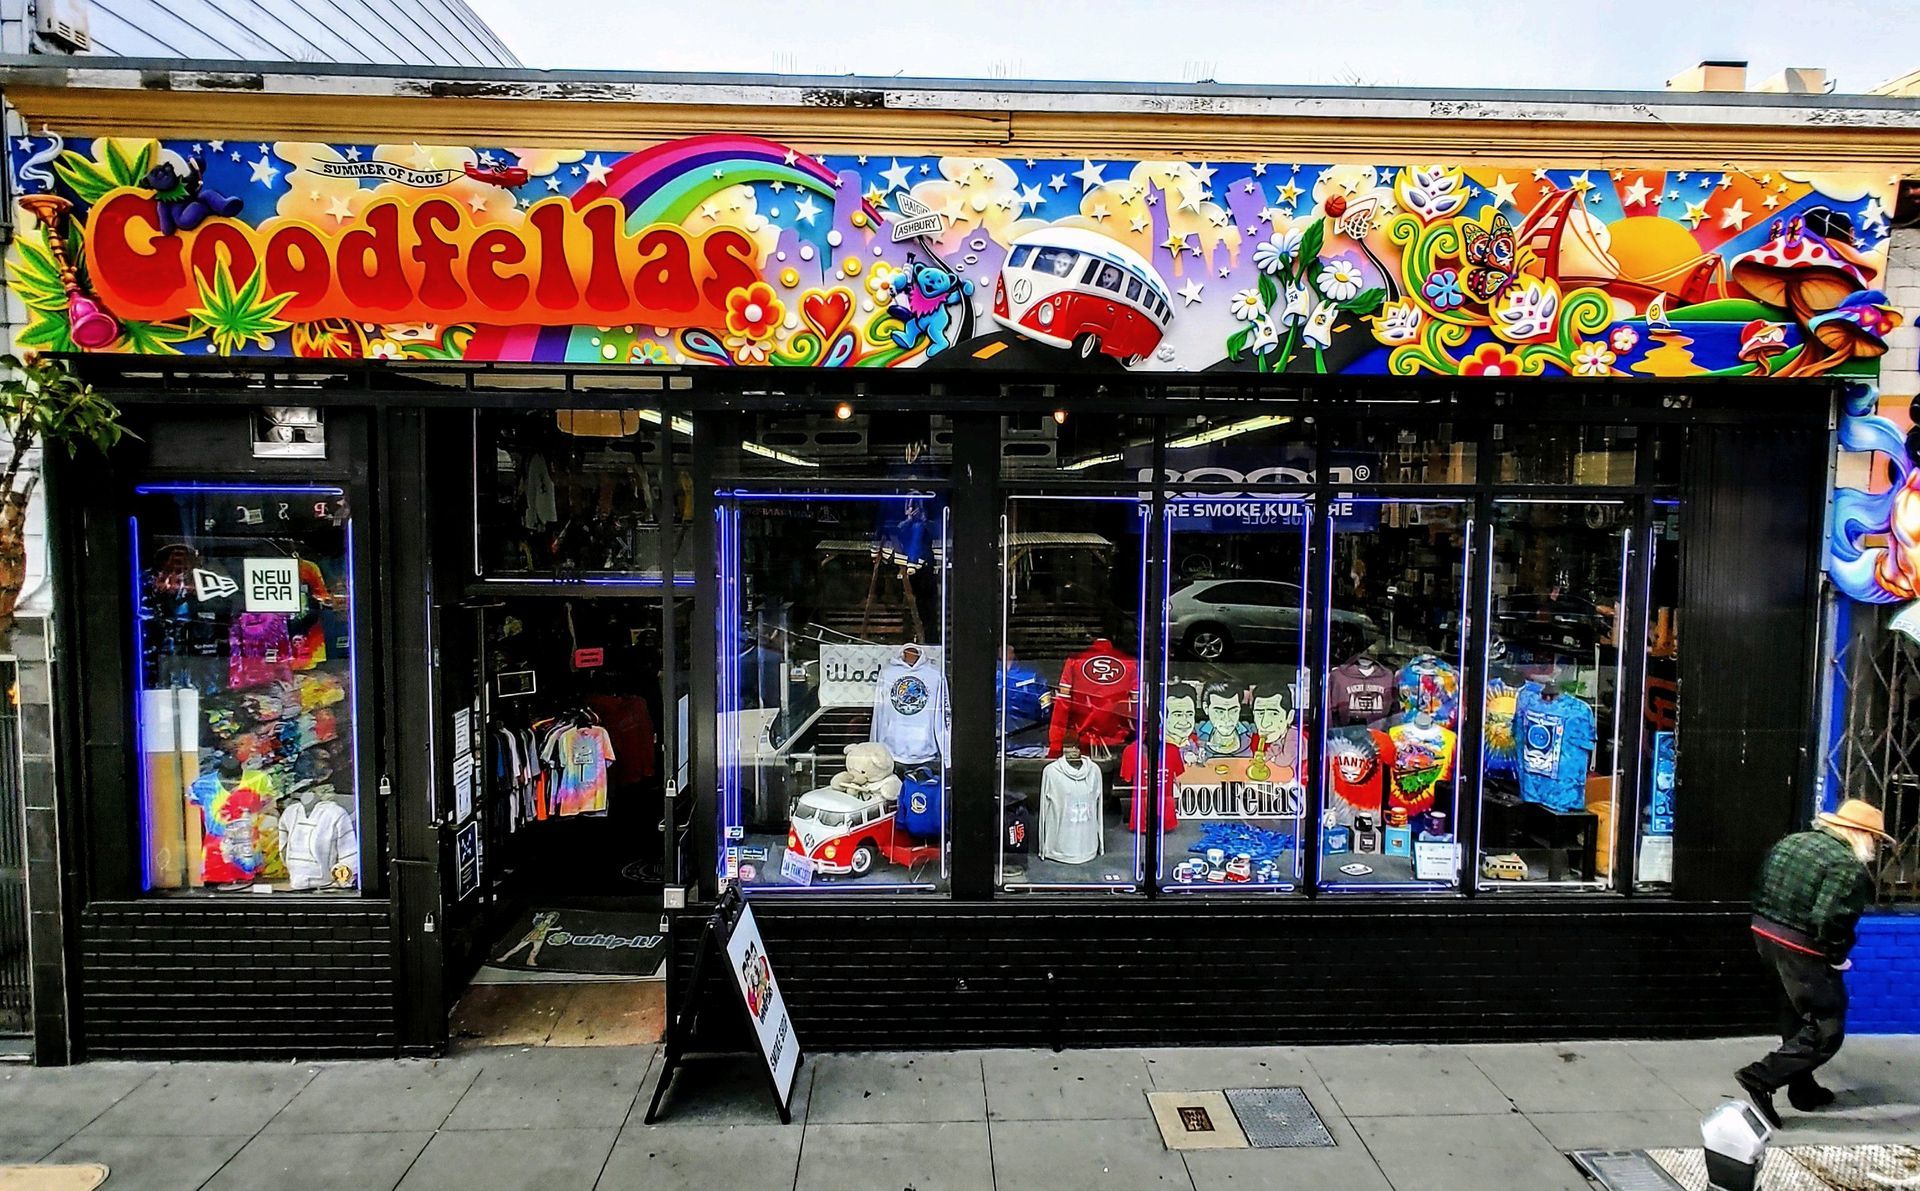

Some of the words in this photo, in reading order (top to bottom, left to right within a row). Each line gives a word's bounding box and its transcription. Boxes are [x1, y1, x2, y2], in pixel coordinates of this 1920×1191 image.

[323, 163, 386, 176] SUMMER
[388, 168, 406, 179] OF
[897, 217, 937, 237] ASHBURY
[93, 188, 759, 313] Goodfellas
[1192, 503, 1261, 517] SMOKE
[252, 570, 291, 585] NEW
[253, 586, 293, 601] ERA
[1092, 659, 1119, 681] SF
